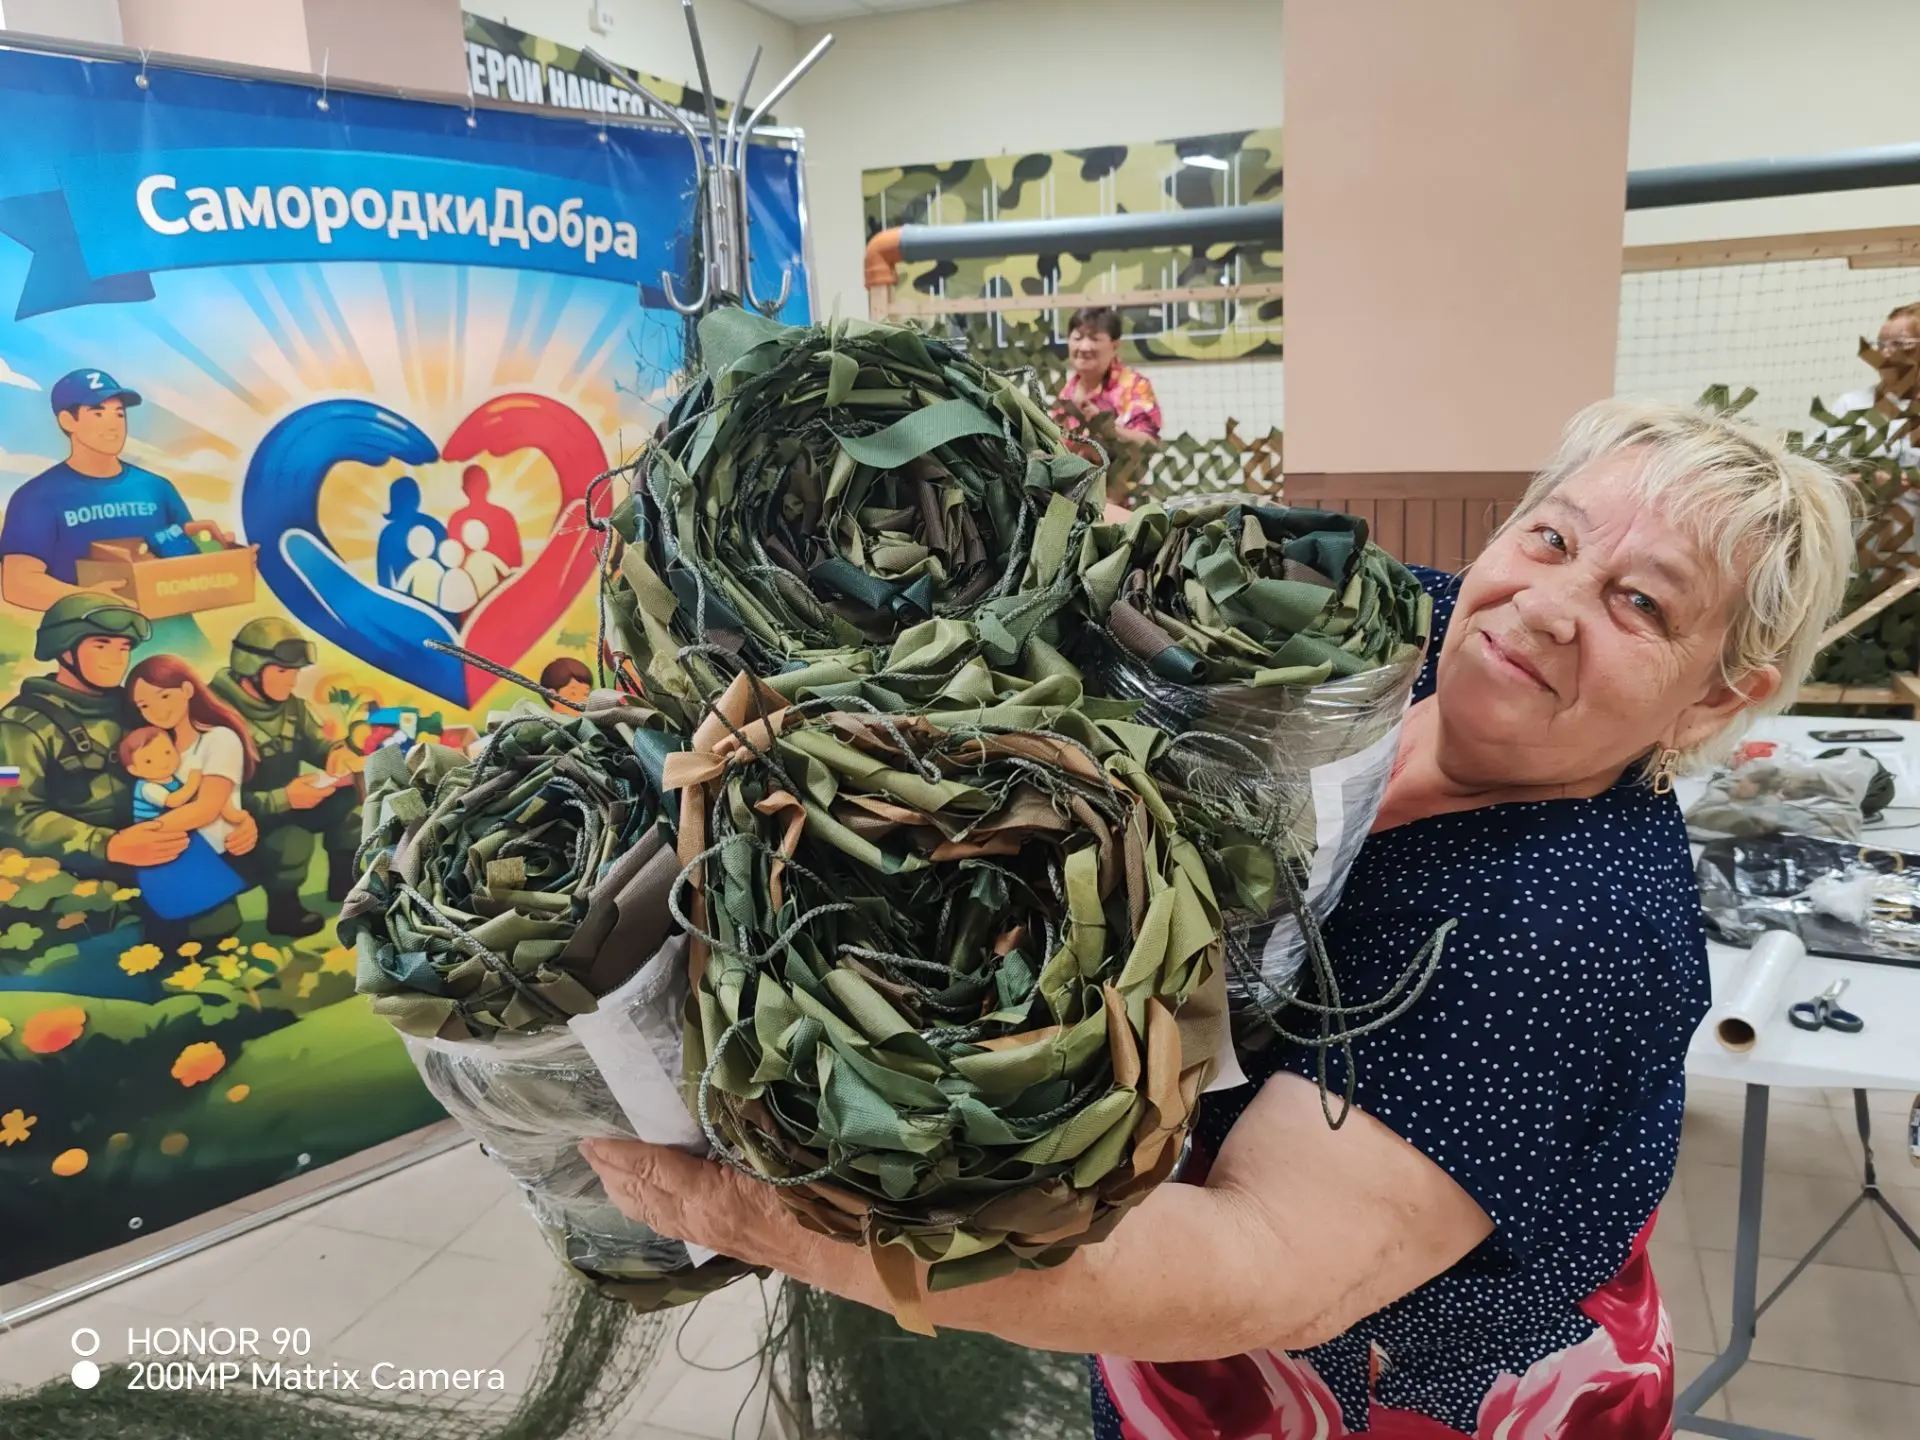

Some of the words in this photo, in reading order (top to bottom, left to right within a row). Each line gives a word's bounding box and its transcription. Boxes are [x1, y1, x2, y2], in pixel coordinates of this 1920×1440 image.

[463, 41, 545, 104] ЕРОИ
[136, 174, 638, 263] СамородкиДобра
[87, 372, 104, 390] Z
[64, 502, 157, 528] ВОЛОНТЕР
